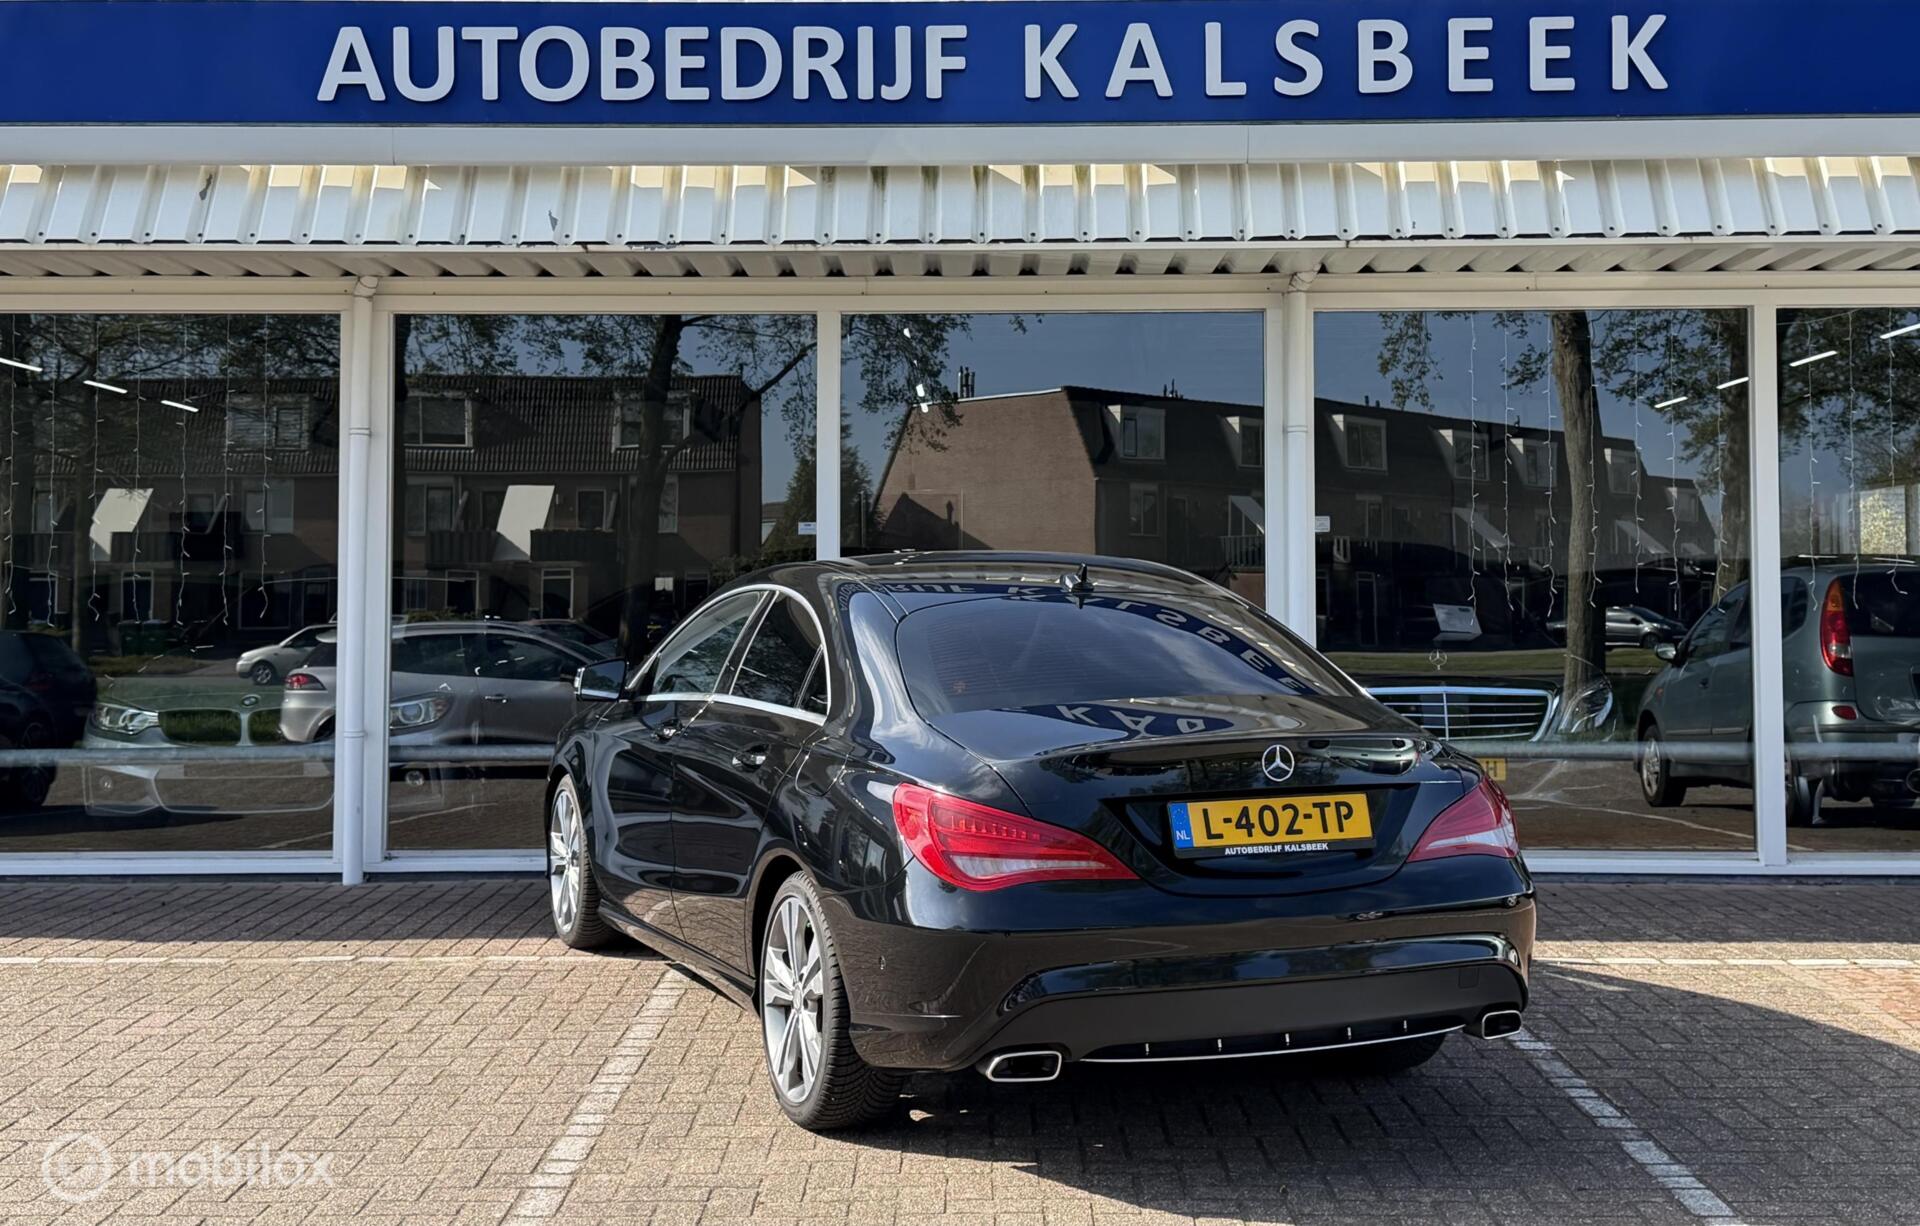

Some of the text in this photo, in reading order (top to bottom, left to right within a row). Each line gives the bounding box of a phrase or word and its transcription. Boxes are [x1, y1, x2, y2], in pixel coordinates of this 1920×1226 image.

[316, 14, 1669, 102] AUTOBEDRIJF KALSBEEK
[1176, 801, 1354, 841] NL L-402-TP
[1224, 842, 1329, 856] AUTOBEDRIJF KALSBEEK
